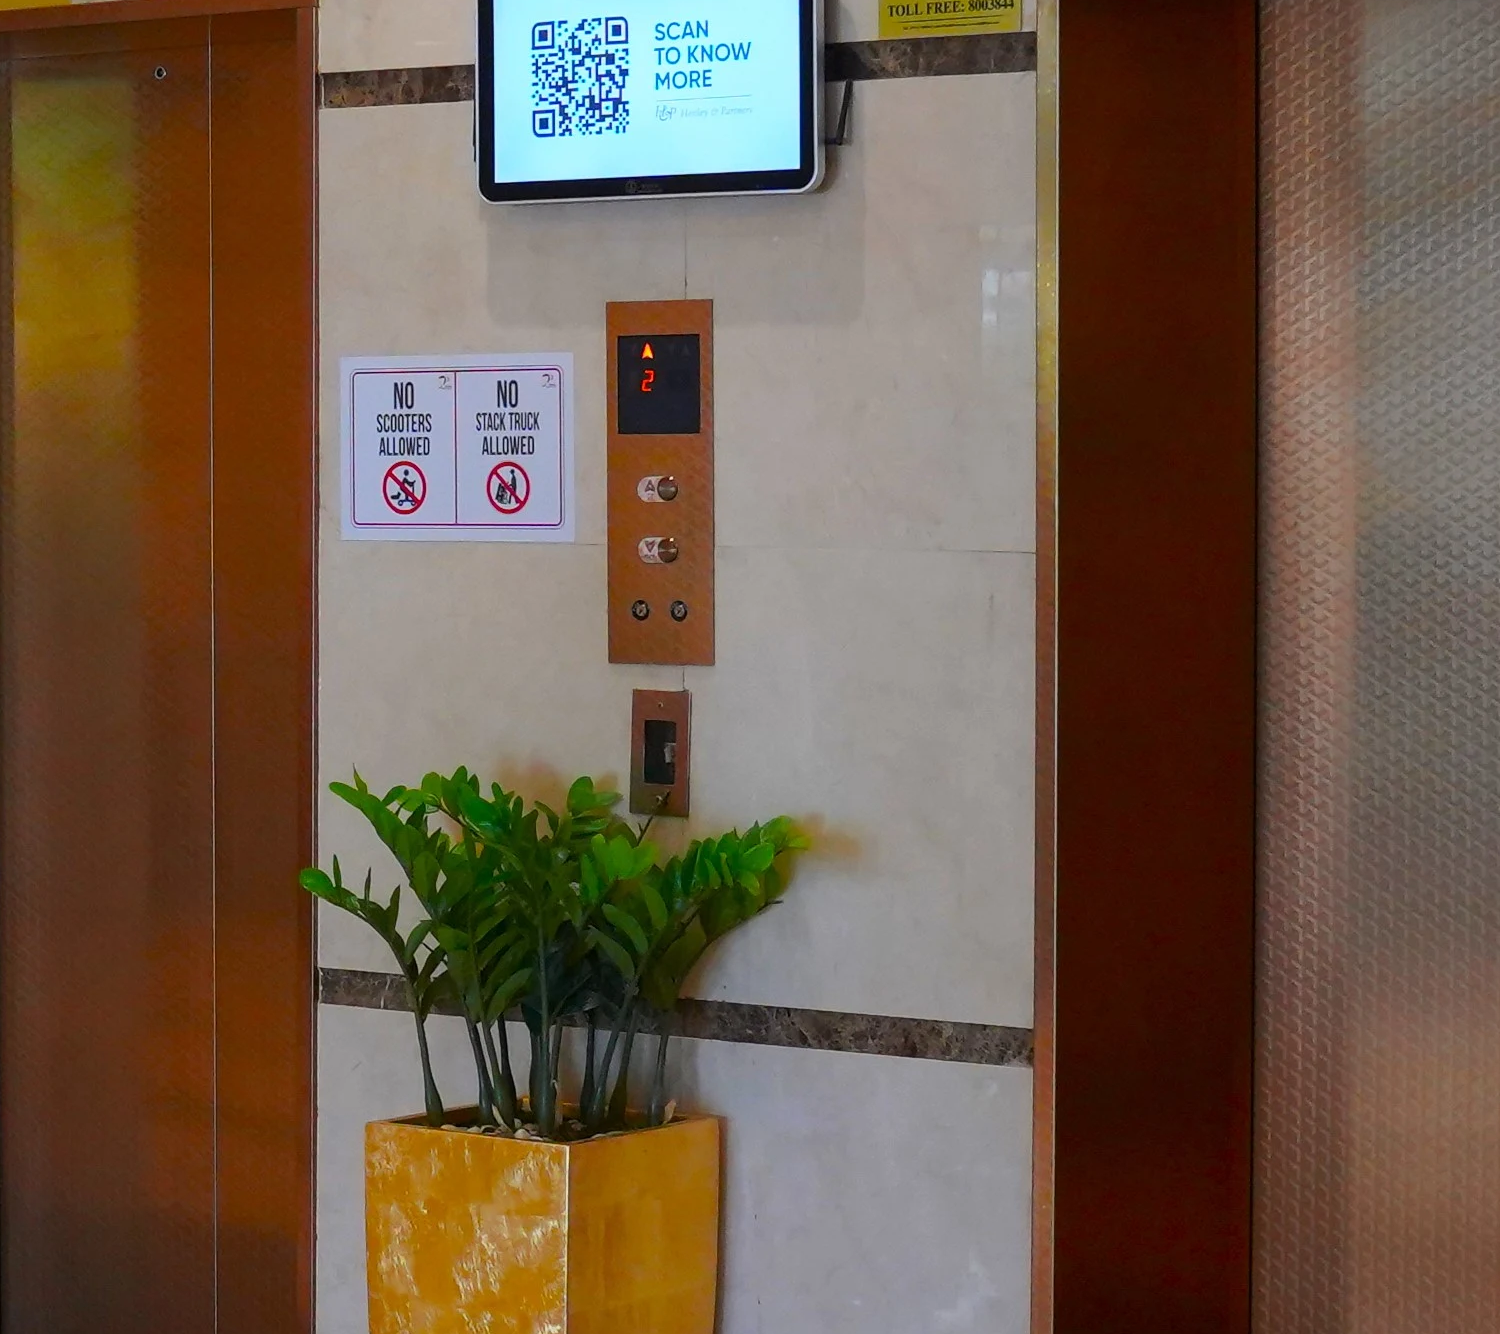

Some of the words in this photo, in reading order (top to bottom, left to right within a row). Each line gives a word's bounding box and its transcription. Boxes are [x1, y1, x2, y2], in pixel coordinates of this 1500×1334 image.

[887, 4, 923, 17] TOLL
[926, 1, 965, 14] FREE:
[655, 20, 709, 41] SCAN
[654, 46, 681, 65] TO
[687, 42, 752, 63] KNOW
[655, 69, 712, 90] MORE
[641, 370, 654, 392] 2
[393, 382, 414, 409] NO
[497, 380, 518, 408] NO
[376, 413, 432, 433] SCOOTERS
[476, 413, 506, 431] STACK
[508, 412, 540, 431] TRUCK
[379, 437, 430, 456] ALLOWED
[482, 436, 535, 455] ALLOWED
